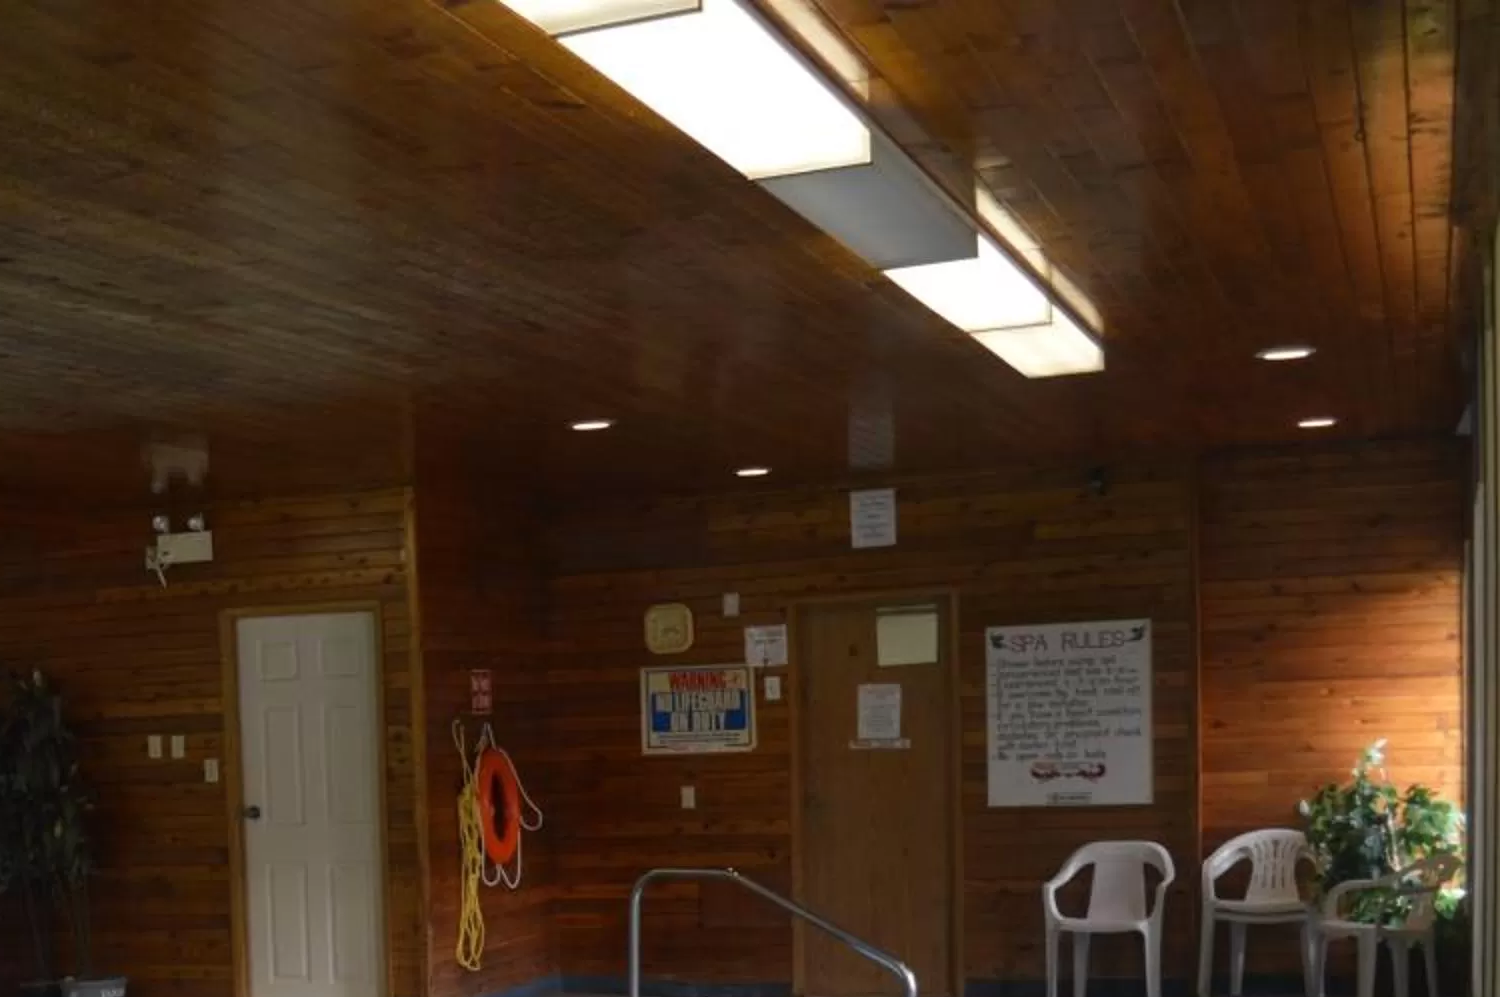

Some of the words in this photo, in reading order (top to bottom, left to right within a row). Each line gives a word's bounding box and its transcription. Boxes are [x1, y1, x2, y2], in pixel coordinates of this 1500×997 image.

[1010, 633, 1049, 653] SPA
[1061, 630, 1126, 652] RULES
[668, 671, 727, 692] WARNING
